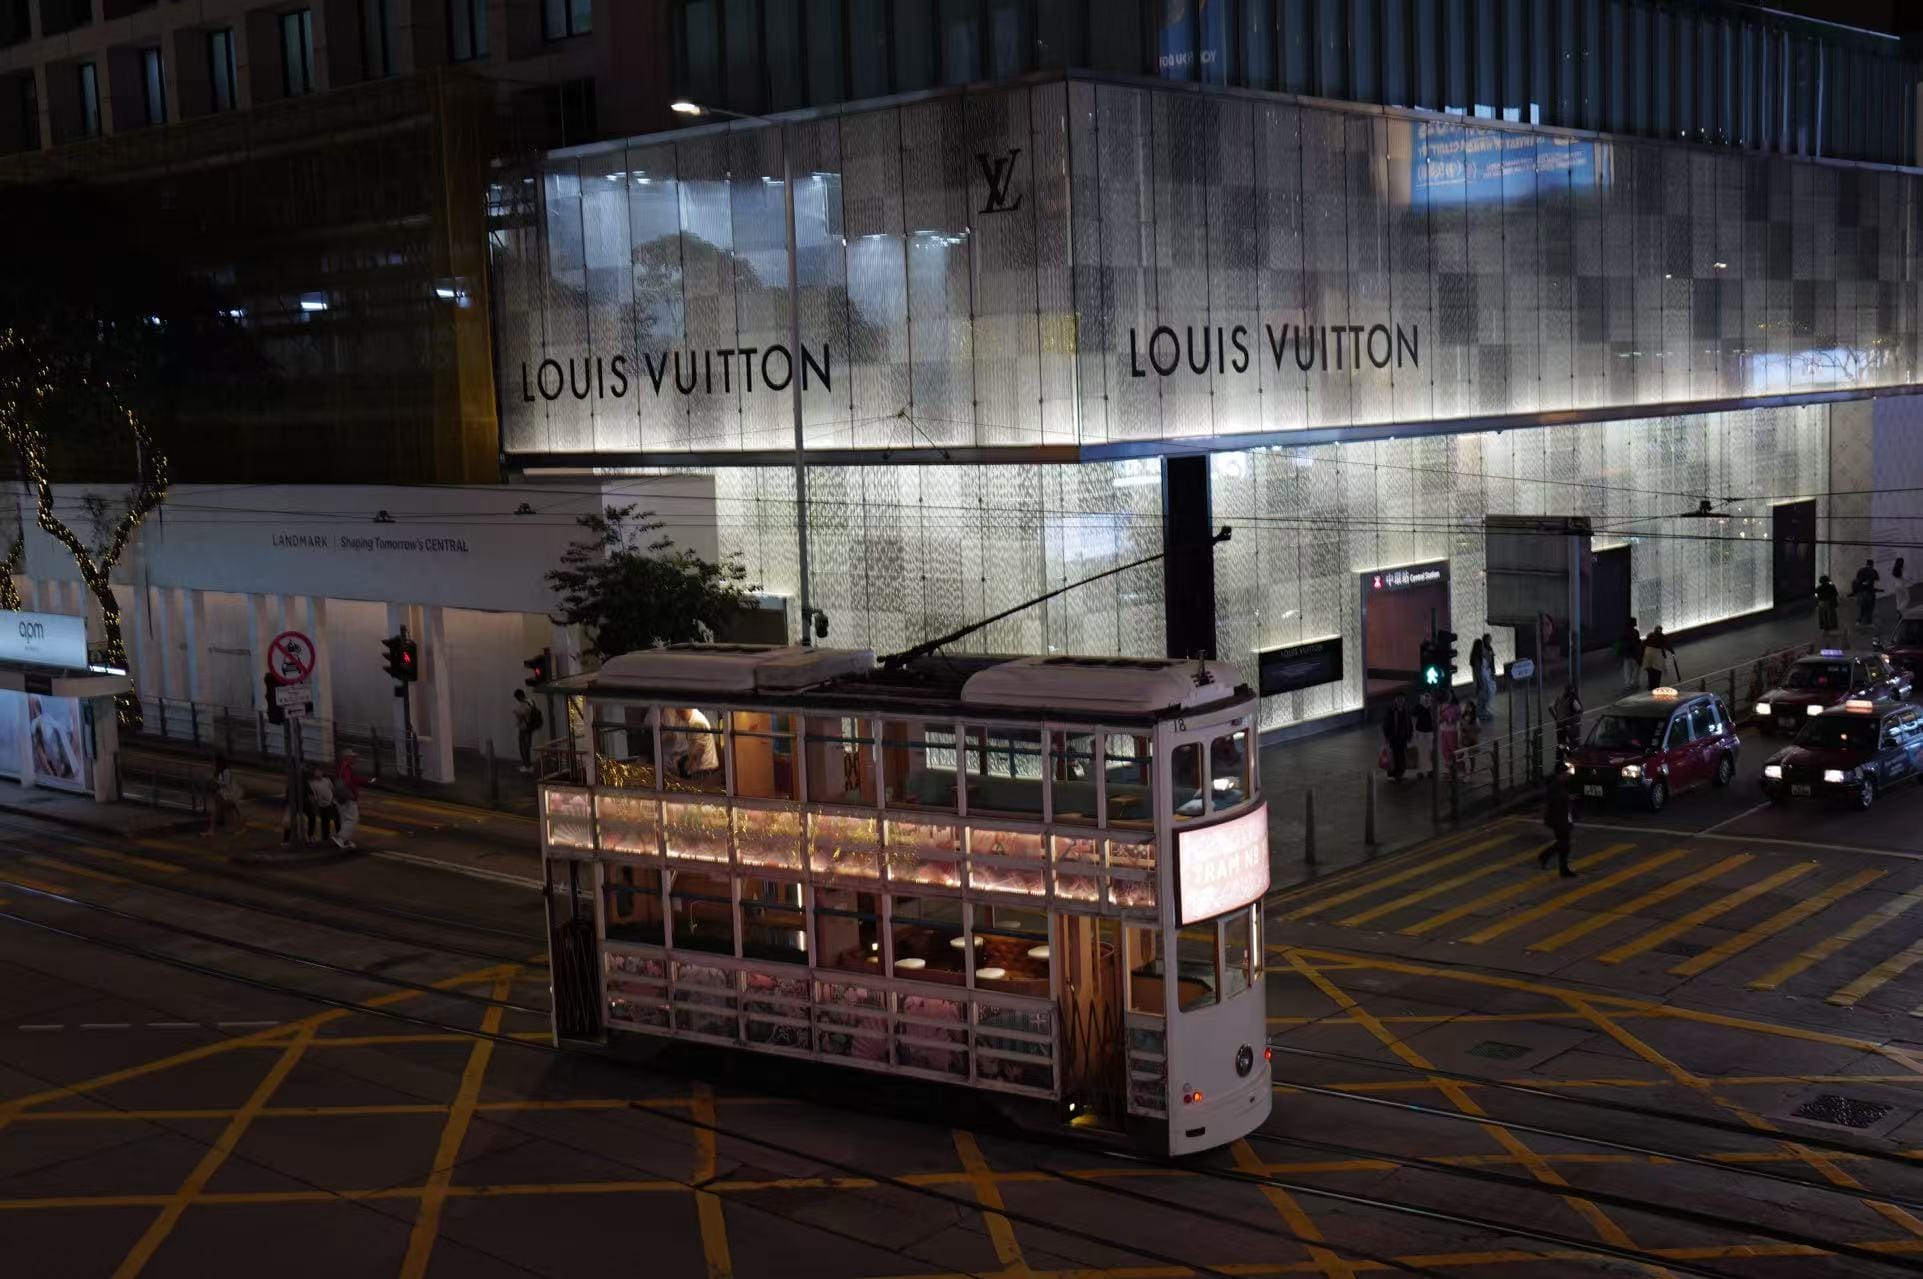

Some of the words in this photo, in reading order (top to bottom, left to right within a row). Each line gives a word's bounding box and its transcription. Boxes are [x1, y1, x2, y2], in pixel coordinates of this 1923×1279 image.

[1129, 325, 1249, 378] LOUIS
[1266, 322, 1419, 372] VUITTON
[522, 353, 628, 402] LOUIS
[645, 343, 832, 397] VUITTON
[272, 534, 328, 548] LANDMARK
[341, 536, 373, 551] Shaping
[374, 536, 424, 551] Tomorrow's
[425, 538, 469, 553] CENTRAL
[19, 621, 44, 643] apm
[1174, 718, 1186, 733] 18
